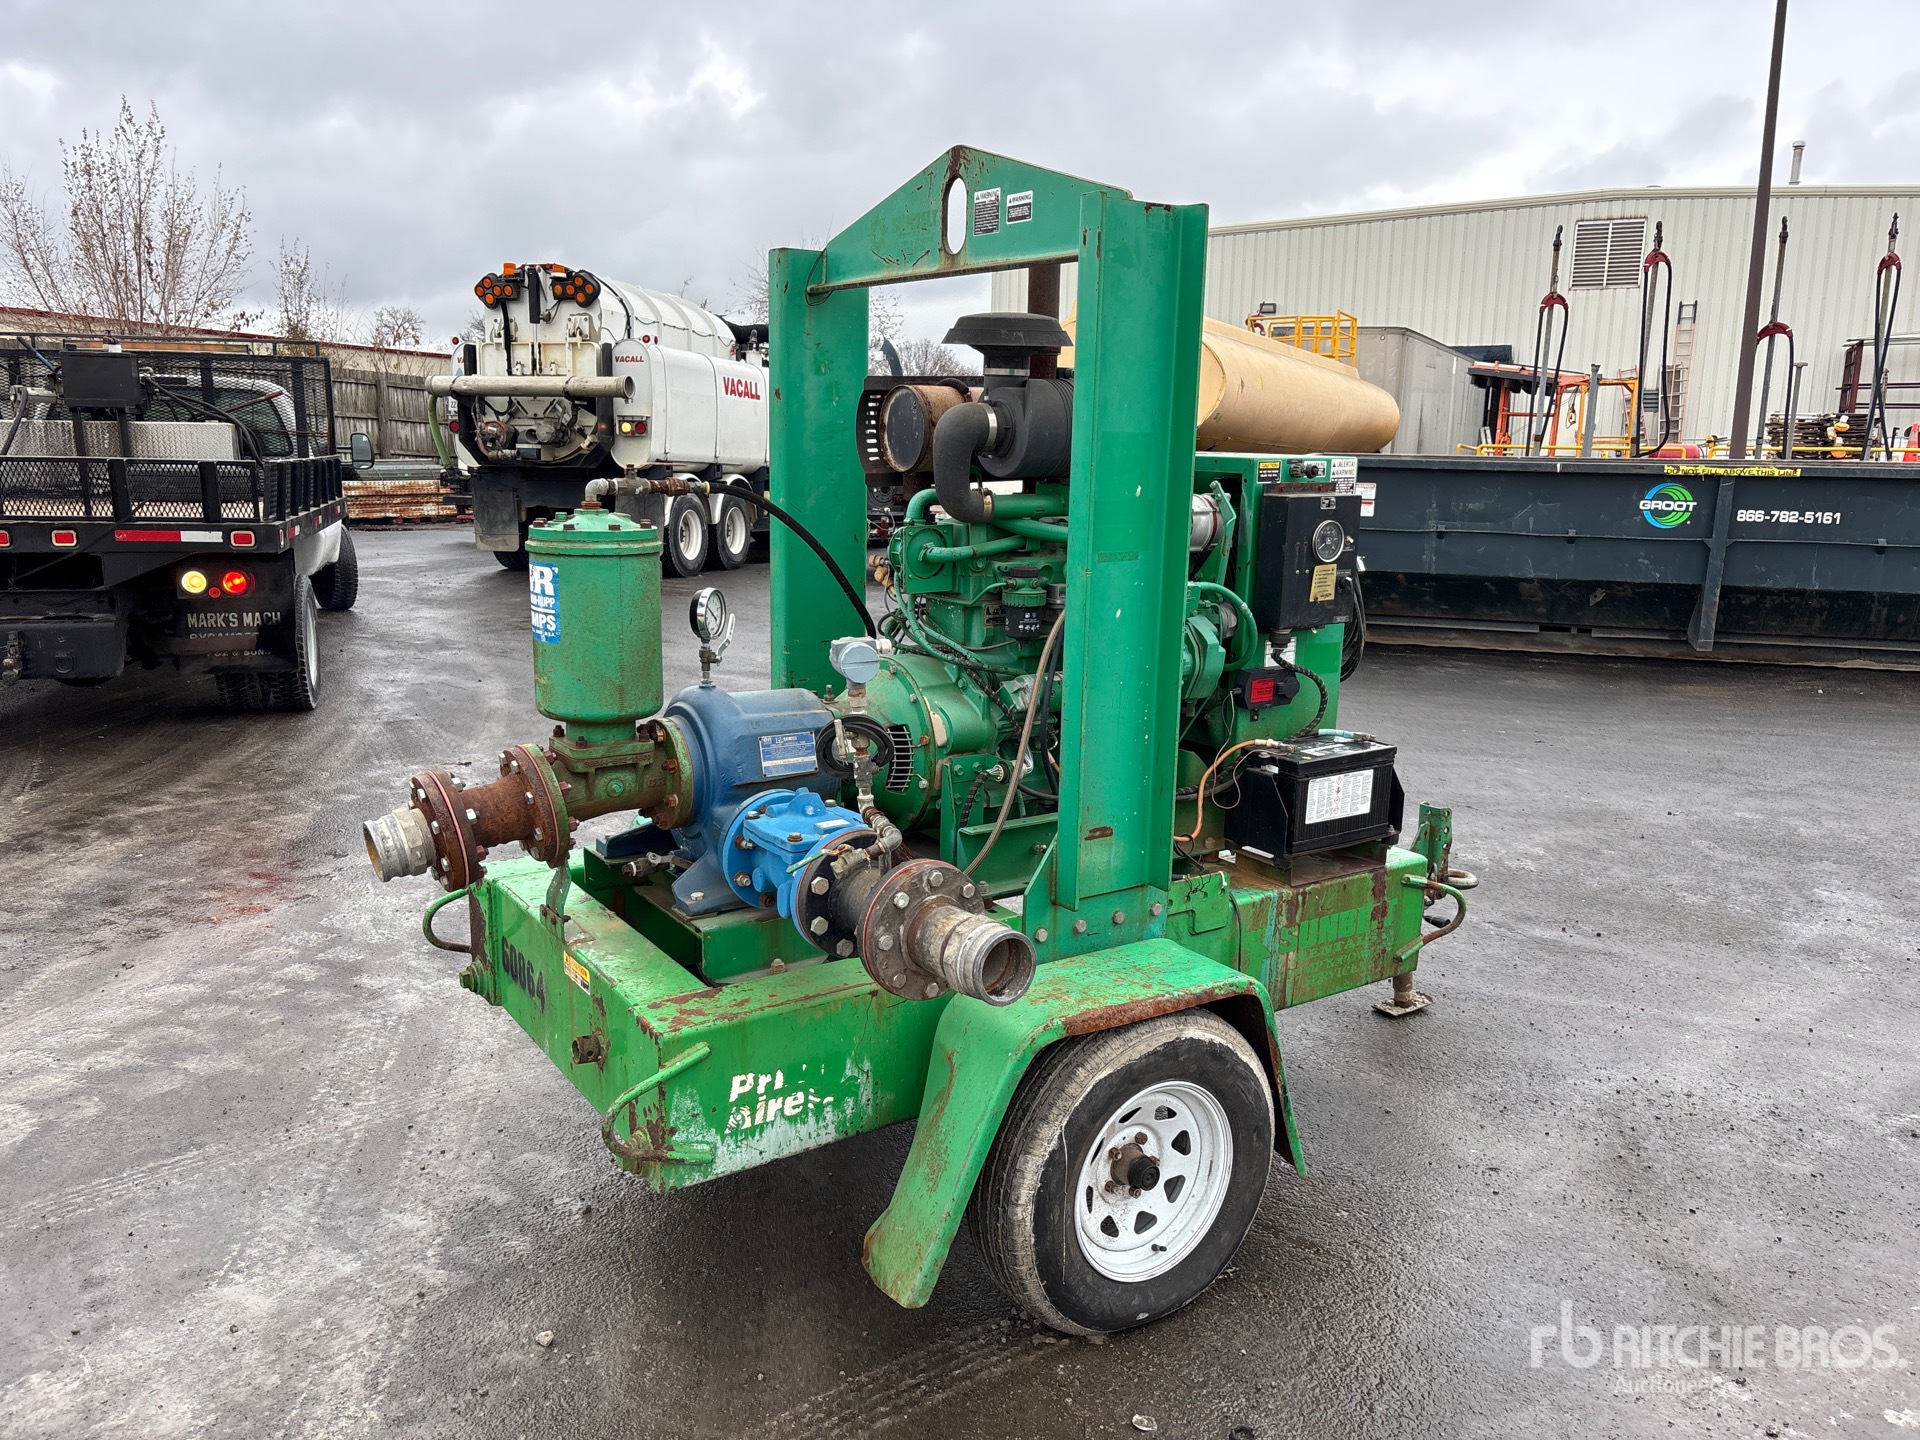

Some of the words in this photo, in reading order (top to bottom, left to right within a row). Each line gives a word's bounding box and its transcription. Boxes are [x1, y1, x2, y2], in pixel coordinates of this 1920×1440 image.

[723, 376, 760, 400] VACALL
[1639, 500, 1697, 511] GROOT
[1737, 510, 1841, 524] 866-782-5161
[187, 612, 239, 628] MARK'S
[243, 611, 281, 627] MACH
